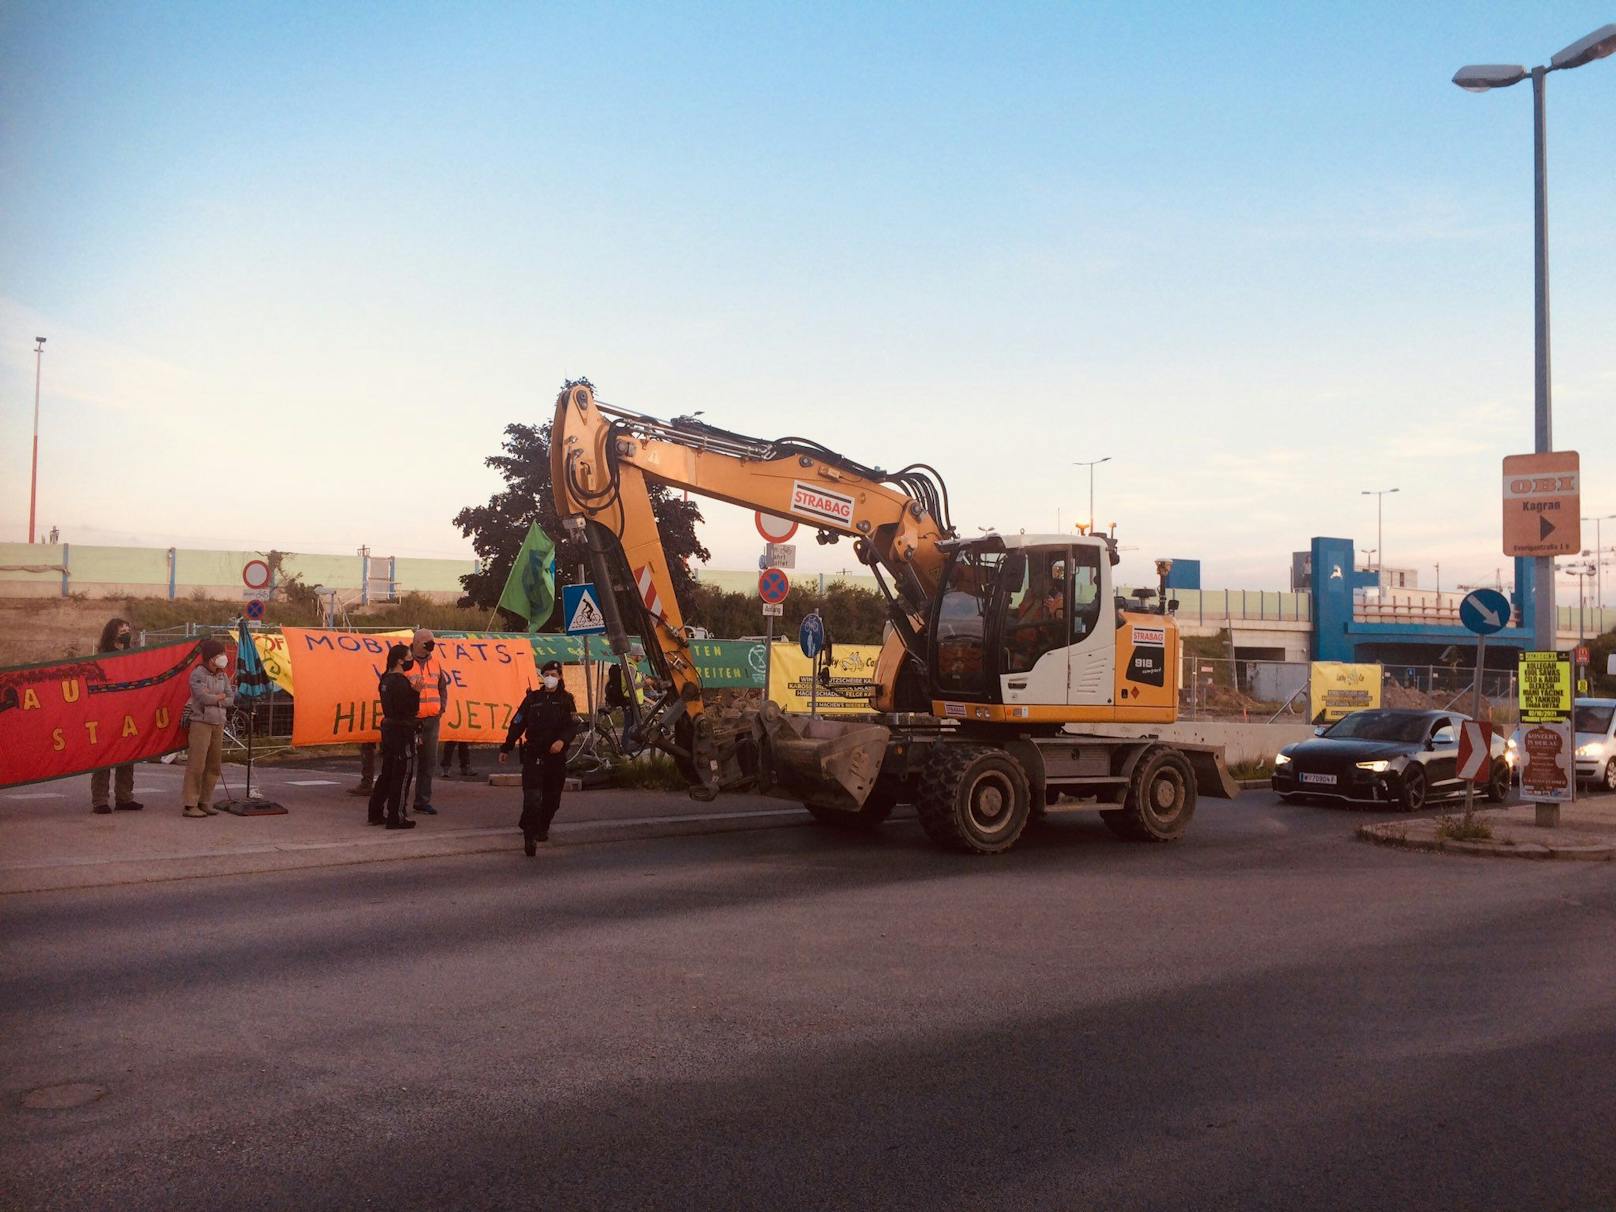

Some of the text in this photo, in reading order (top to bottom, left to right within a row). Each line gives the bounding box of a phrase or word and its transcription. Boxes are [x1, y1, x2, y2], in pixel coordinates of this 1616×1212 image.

[1510, 476, 1575, 494] OBI
[795, 491, 850, 517] STRABAG
[1522, 501, 1561, 513] Kagran
[1133, 631, 1164, 641] STRABAG
[1135, 658, 1153, 668] 918
